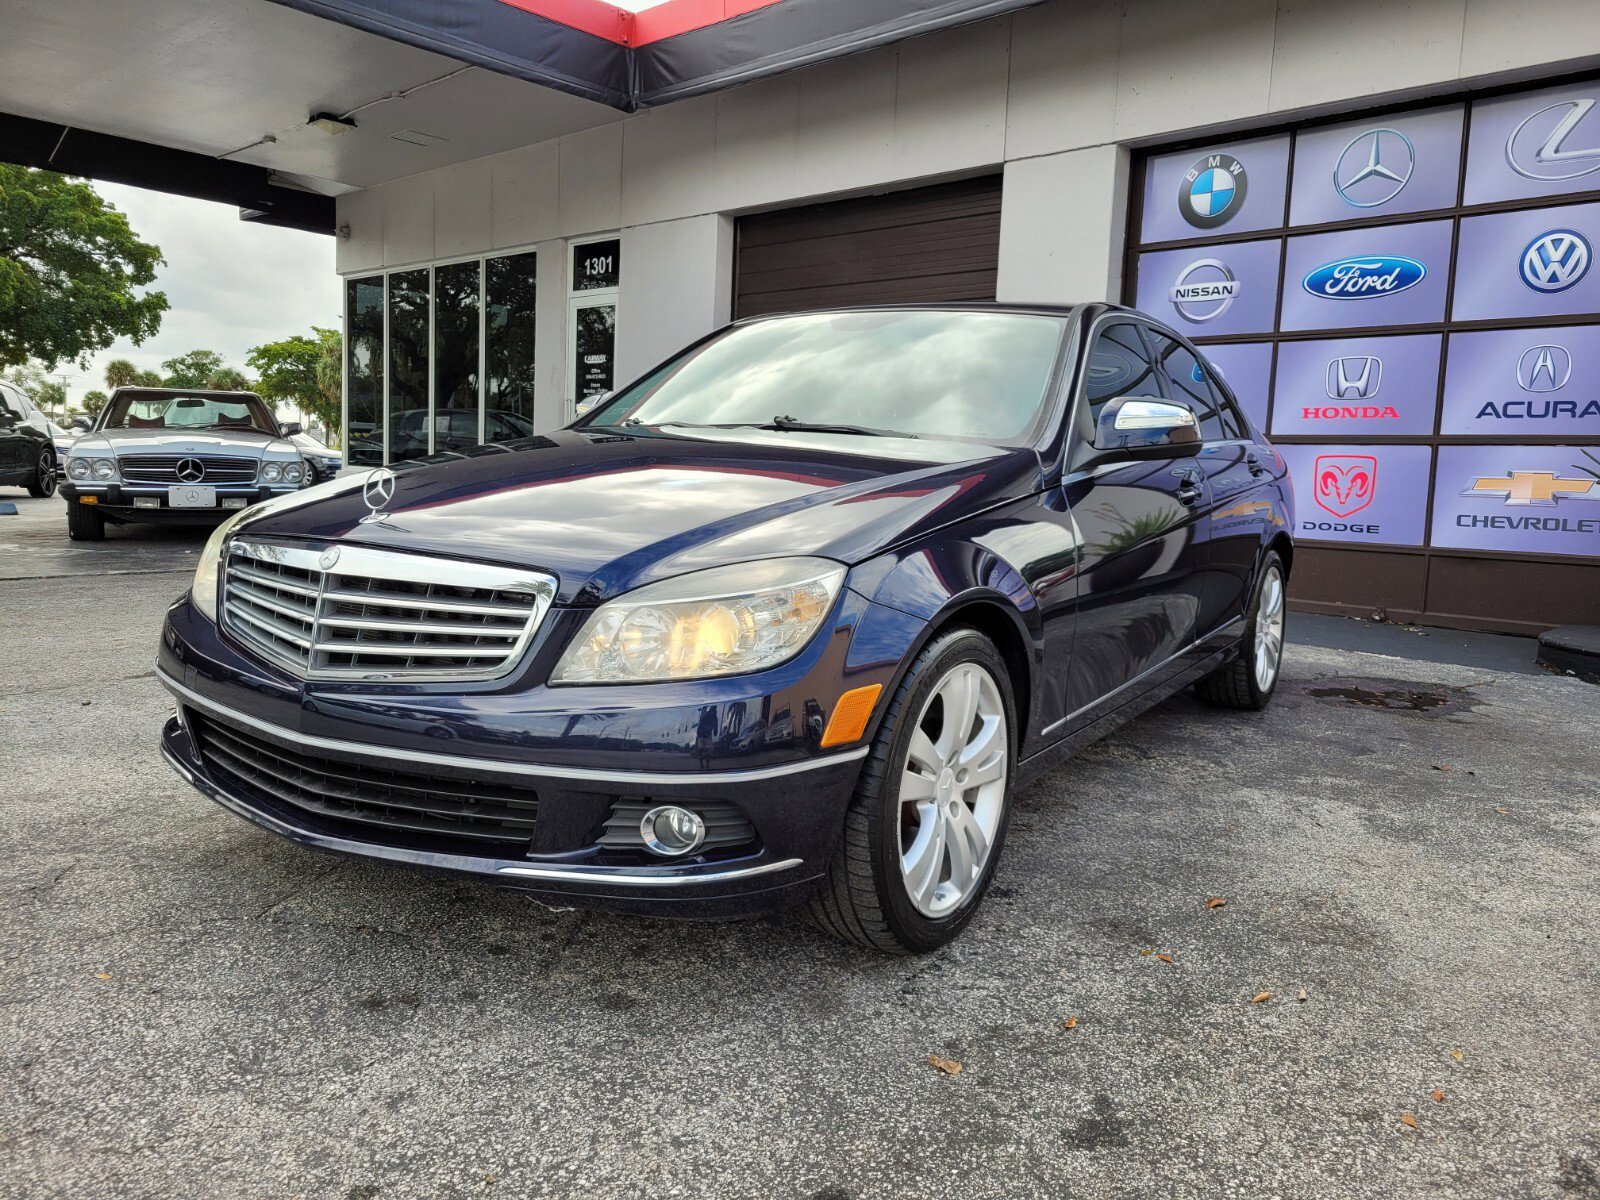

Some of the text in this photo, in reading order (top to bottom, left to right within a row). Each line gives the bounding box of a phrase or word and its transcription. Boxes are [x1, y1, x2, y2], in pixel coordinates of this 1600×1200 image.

[1186, 154, 1243, 182] BMW
[584, 255, 613, 276] 1301
[1325, 261, 1399, 292] Ford
[1174, 283, 1234, 300] NISSAN
[1302, 407, 1400, 419] HONDA
[1475, 400, 1600, 419] ACURA
[1303, 521, 1380, 534] DODGE
